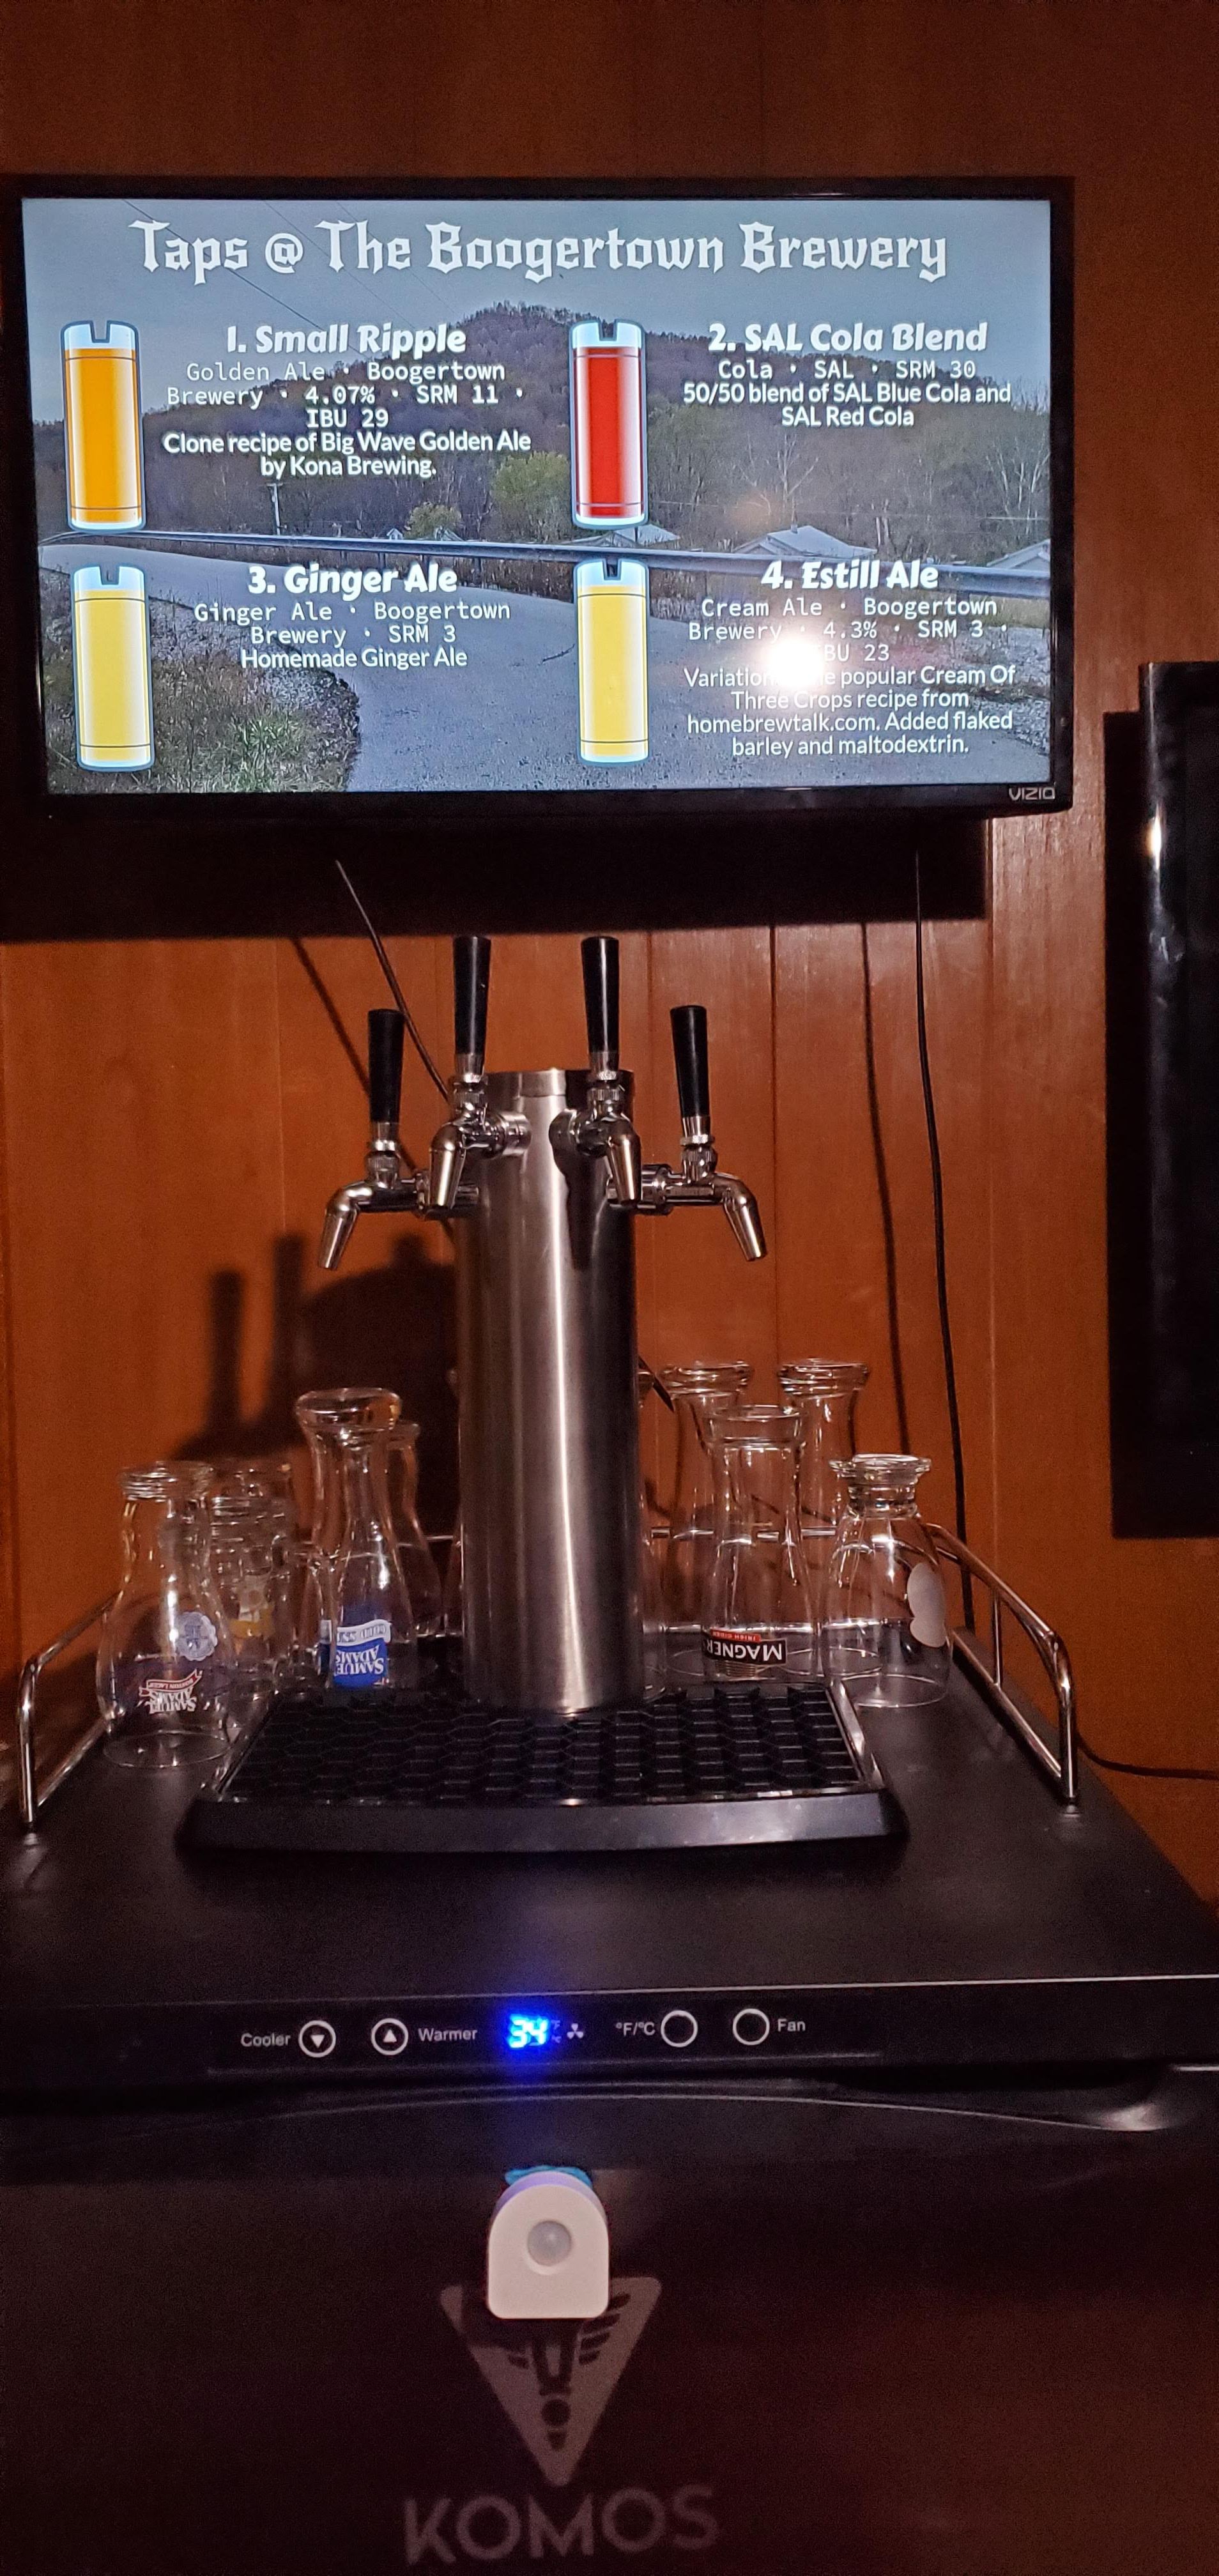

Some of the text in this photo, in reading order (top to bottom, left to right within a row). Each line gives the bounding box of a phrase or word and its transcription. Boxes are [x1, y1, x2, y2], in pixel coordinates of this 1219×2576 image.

[129, 220, 947, 285] Taps @ The Boogertown Brewery
[256, 324, 348, 353] Small
[357, 324, 466, 360] Ripple
[709, 322, 987, 351] 2. SAL Cola Blend
[187, 362, 505, 385] Golden Ale Boogertown
[718, 360, 976, 379] Cola SAL SRM 30
[167, 385, 498, 410] Brewery 4.07% SRM 11
[684, 383, 1011, 406] 50/50 blend of SAL Blue Cola and
[307, 409, 388, 427] IBU 29
[781, 406, 914, 427] SAL Red Cola
[164, 431, 532, 457] Clone recipe of Big Wave Golden Ale
[261, 455, 436, 480] by Kona Brewing.
[248, 565, 457, 601] 3. Ginger Ale
[760, 560, 938, 590] 4. Estill Ale
[194, 602, 510, 625] Ginger Ale Boogertown
[702, 597, 998, 619] Cream Ale Boogertown
[250, 625, 456, 647] Brewery SRM 3
[689, 620, 984, 643] Brewery 4.3% SRM 3
[241, 648, 468, 671] Homemade Ginger Ale
[815, 644, 890, 662] BU 23
[841, 667, 916, 689] popular
[920, 666, 986, 686] Cream
[990, 664, 1016, 684] Of
[731, 688, 969, 712] Three Crops recipe from
[687, 710, 1013, 733] homebrewtalk.com. Added flaked
[732, 734, 969, 760] barley and maltodextrin.
[1009, 786, 1055, 801] VIZIO
[144, 1696, 197, 1714] SAMUEL
[149, 1687, 193, 1702] ADAMS
[418, 2027, 479, 2042] Warmer
[509, 2016, 549, 2048] 34
[777, 2018, 806, 2034] Fan
[240, 2033, 291, 2048] Cooler
[404, 2484, 721, 2566] KOMOS
